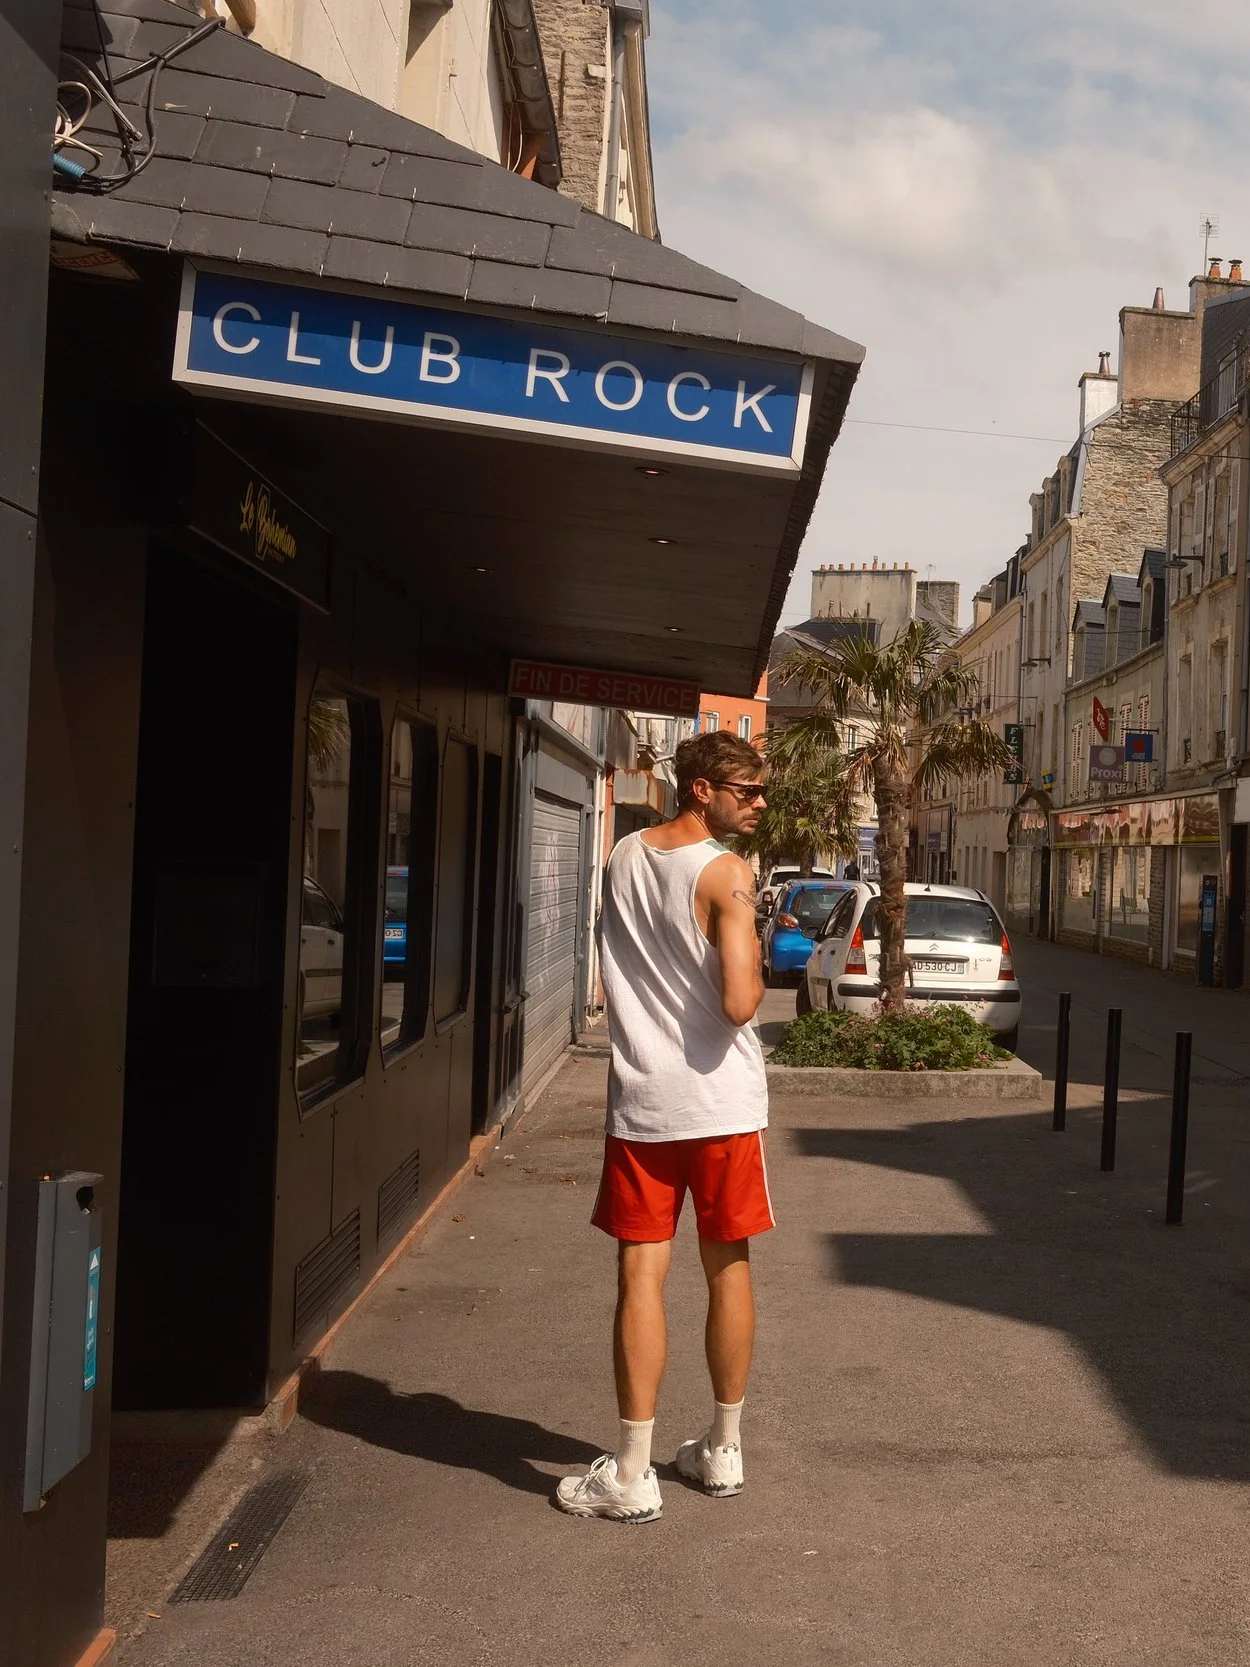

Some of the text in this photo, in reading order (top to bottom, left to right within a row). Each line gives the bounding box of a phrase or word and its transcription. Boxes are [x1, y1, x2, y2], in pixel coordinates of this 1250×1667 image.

[211, 301, 777, 434] CLUB ROCK
[514, 666, 695, 710] FIN DE SERVICE
[1090, 764, 1123, 779] Proxi
[925, 961, 942, 971] 530
[945, 962, 956, 972] CJ
